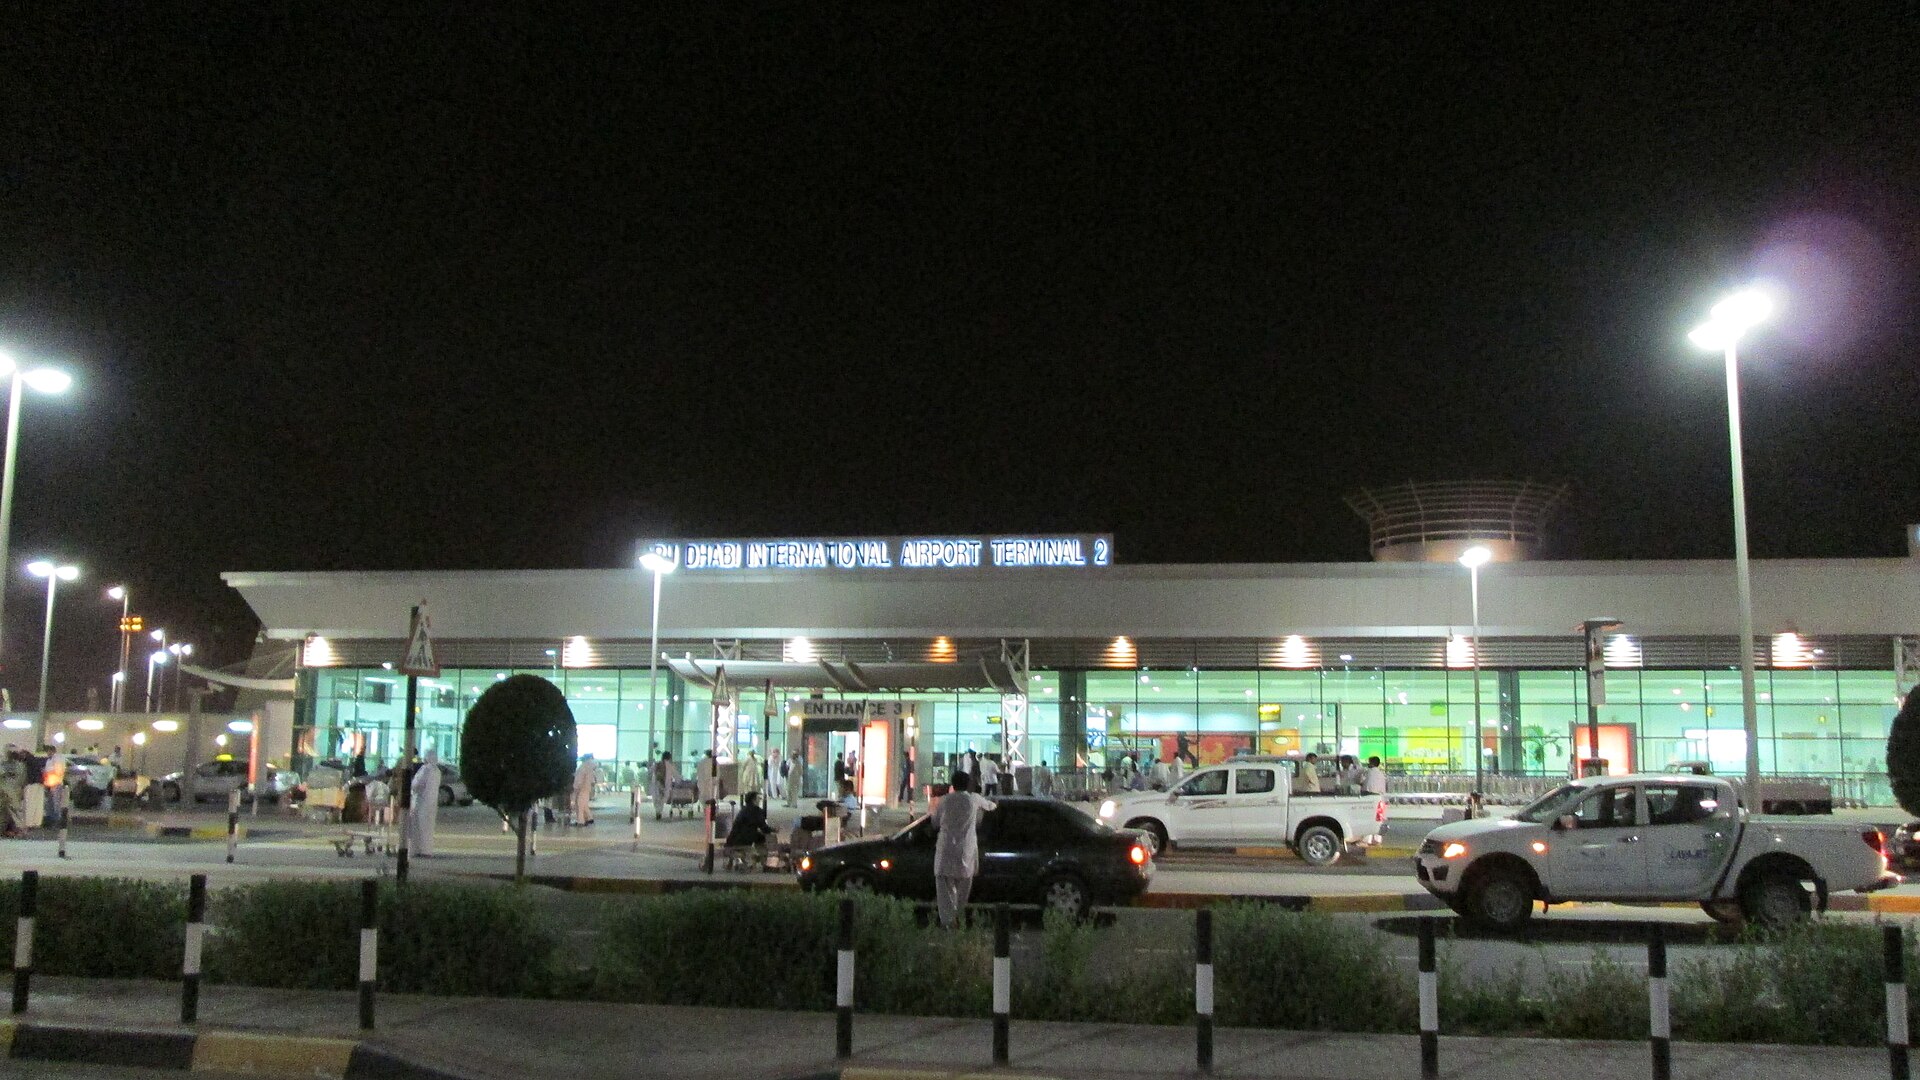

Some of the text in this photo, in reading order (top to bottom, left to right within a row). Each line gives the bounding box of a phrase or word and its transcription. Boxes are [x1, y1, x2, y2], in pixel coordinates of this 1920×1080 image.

[685, 542, 742, 569] DHABI
[745, 541, 891, 569] INTERNATIONAL
[900, 539, 982, 567] AIRPORT
[990, 539, 1086, 567] TERMINAL
[1093, 538, 1108, 566] 2
[803, 702, 903, 715] ENTRANCE 3
